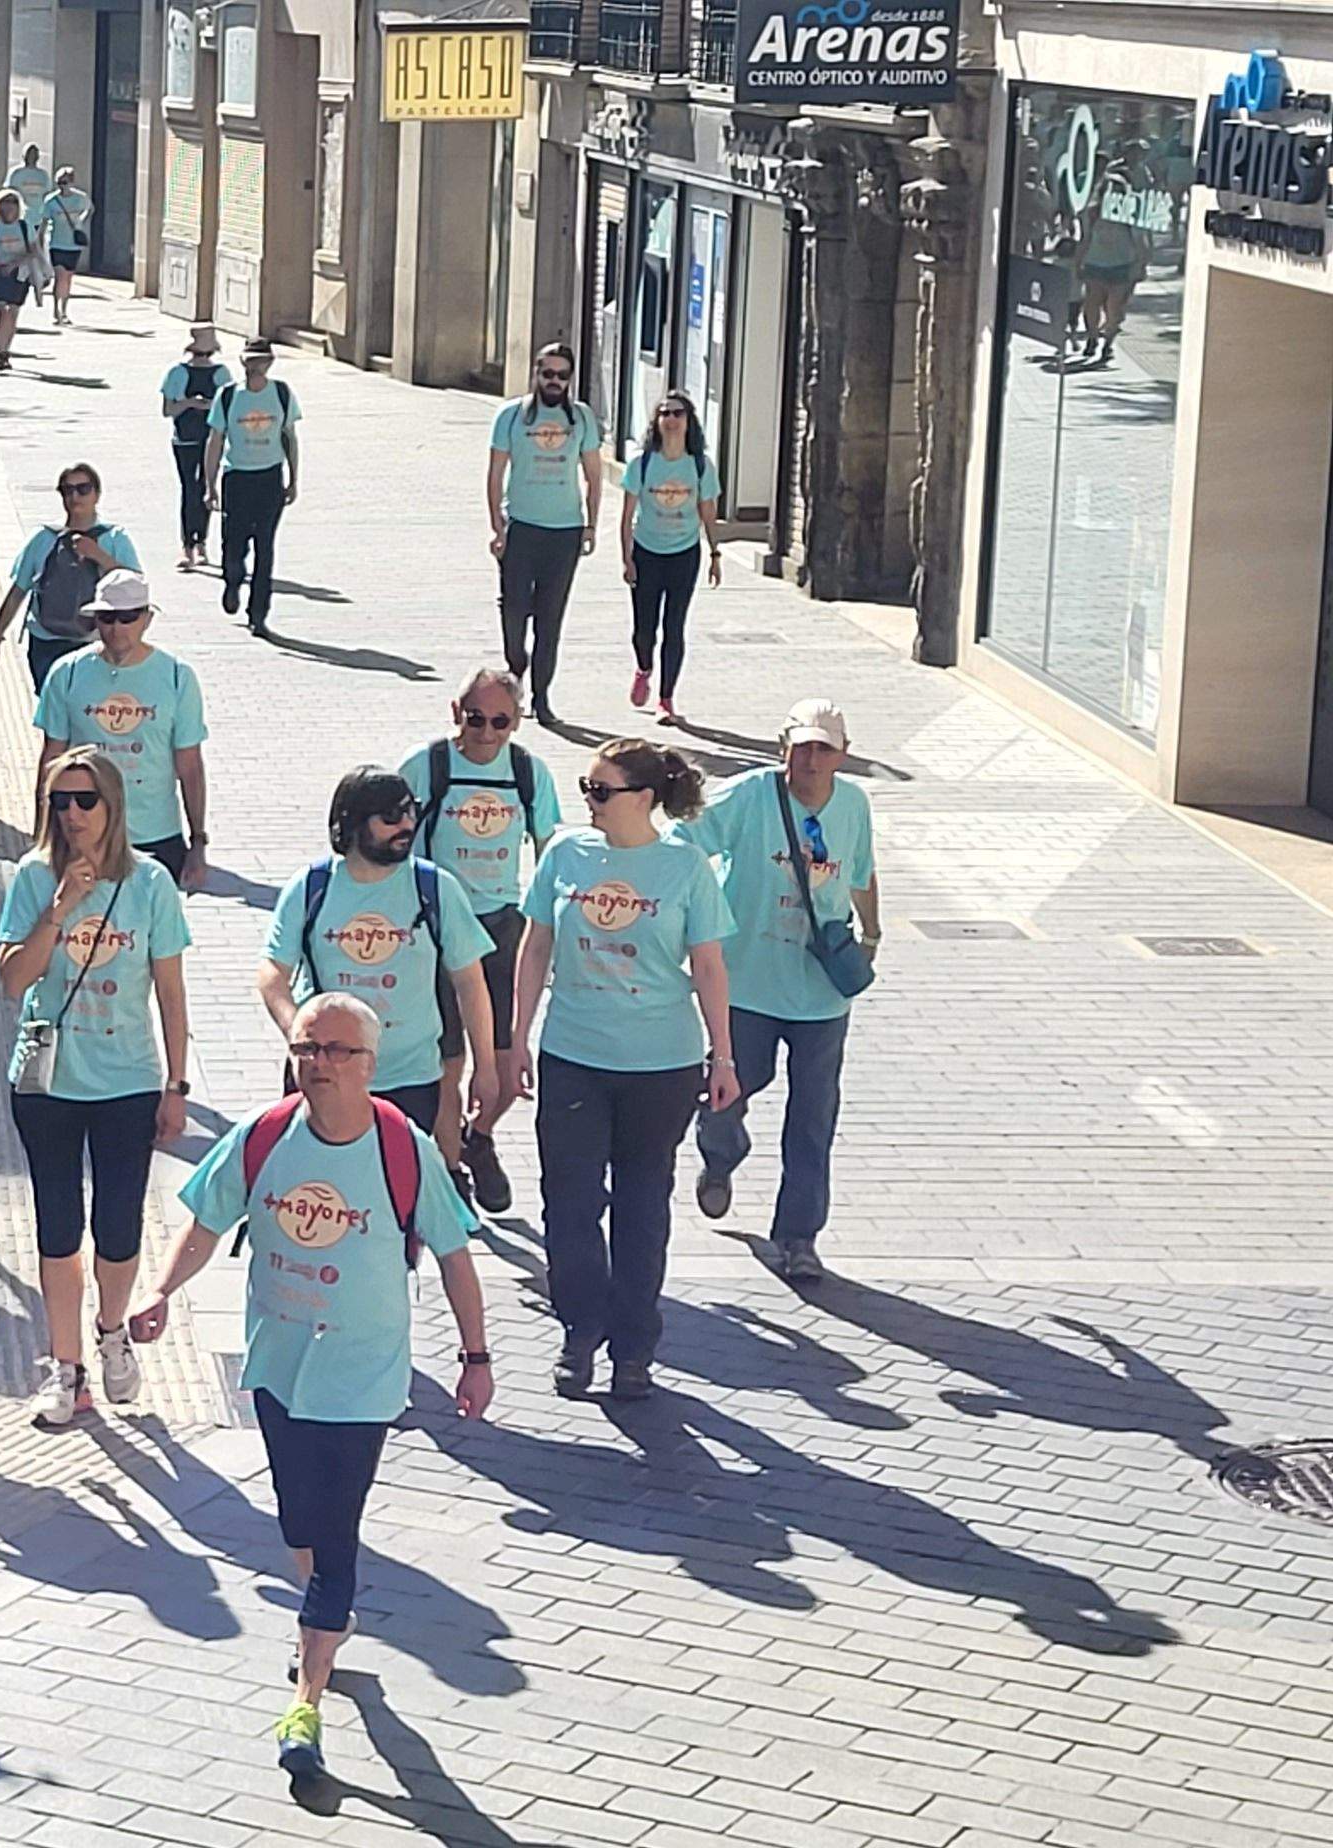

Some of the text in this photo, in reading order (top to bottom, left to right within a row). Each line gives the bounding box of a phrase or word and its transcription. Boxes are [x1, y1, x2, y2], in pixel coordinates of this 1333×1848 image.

[871, 9, 945, 22] desde 1888
[748, 15, 951, 63] Arenas
[395, 36, 514, 100] ASCASO
[748, 67, 947, 86] CENTRO ÓPTICO Y AUDITIVO
[263, 1192, 372, 1235] +mayores
